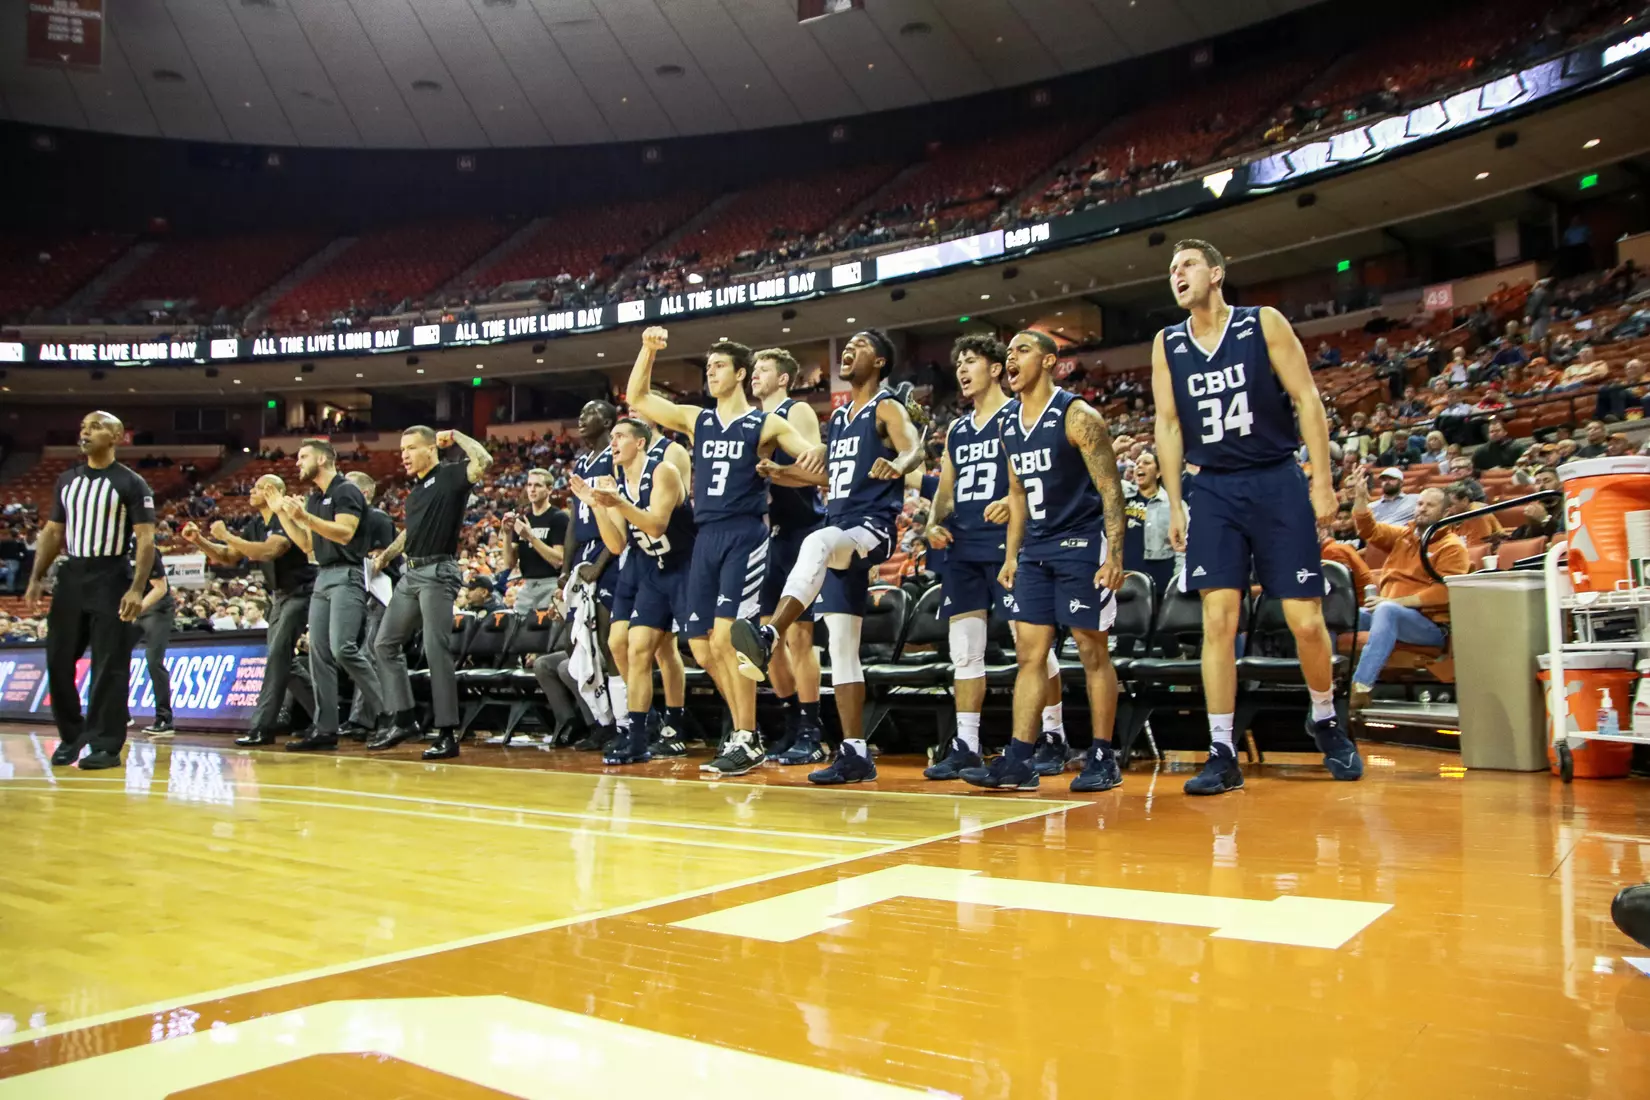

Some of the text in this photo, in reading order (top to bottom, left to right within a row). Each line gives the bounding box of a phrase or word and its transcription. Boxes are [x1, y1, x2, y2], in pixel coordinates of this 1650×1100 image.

[659, 271, 816, 316] ALL THE LIVE LONG DAY
[1427, 289, 1449, 306] 49
[455, 307, 603, 341] ALL THE LIVE LONG DAY
[39, 341, 197, 361] ALL THE LIVE LONG DAY
[252, 329, 400, 355] ALL THE LIVE LONG DAY
[1058, 362, 1075, 375] 20
[1187, 363, 1246, 397] CBU
[1197, 391, 1254, 444] 34
[702, 440, 745, 459] CBU
[829, 436, 860, 459] CBU
[955, 438, 999, 465] CBU
[1010, 448, 1052, 475] CBU
[707, 461, 730, 496] 3
[827, 460, 856, 500] 32
[956, 462, 998, 503] 23
[1024, 477, 1046, 520] 2
[236, 666, 267, 679] WOUN
[225, 693, 260, 706] PROJEC
